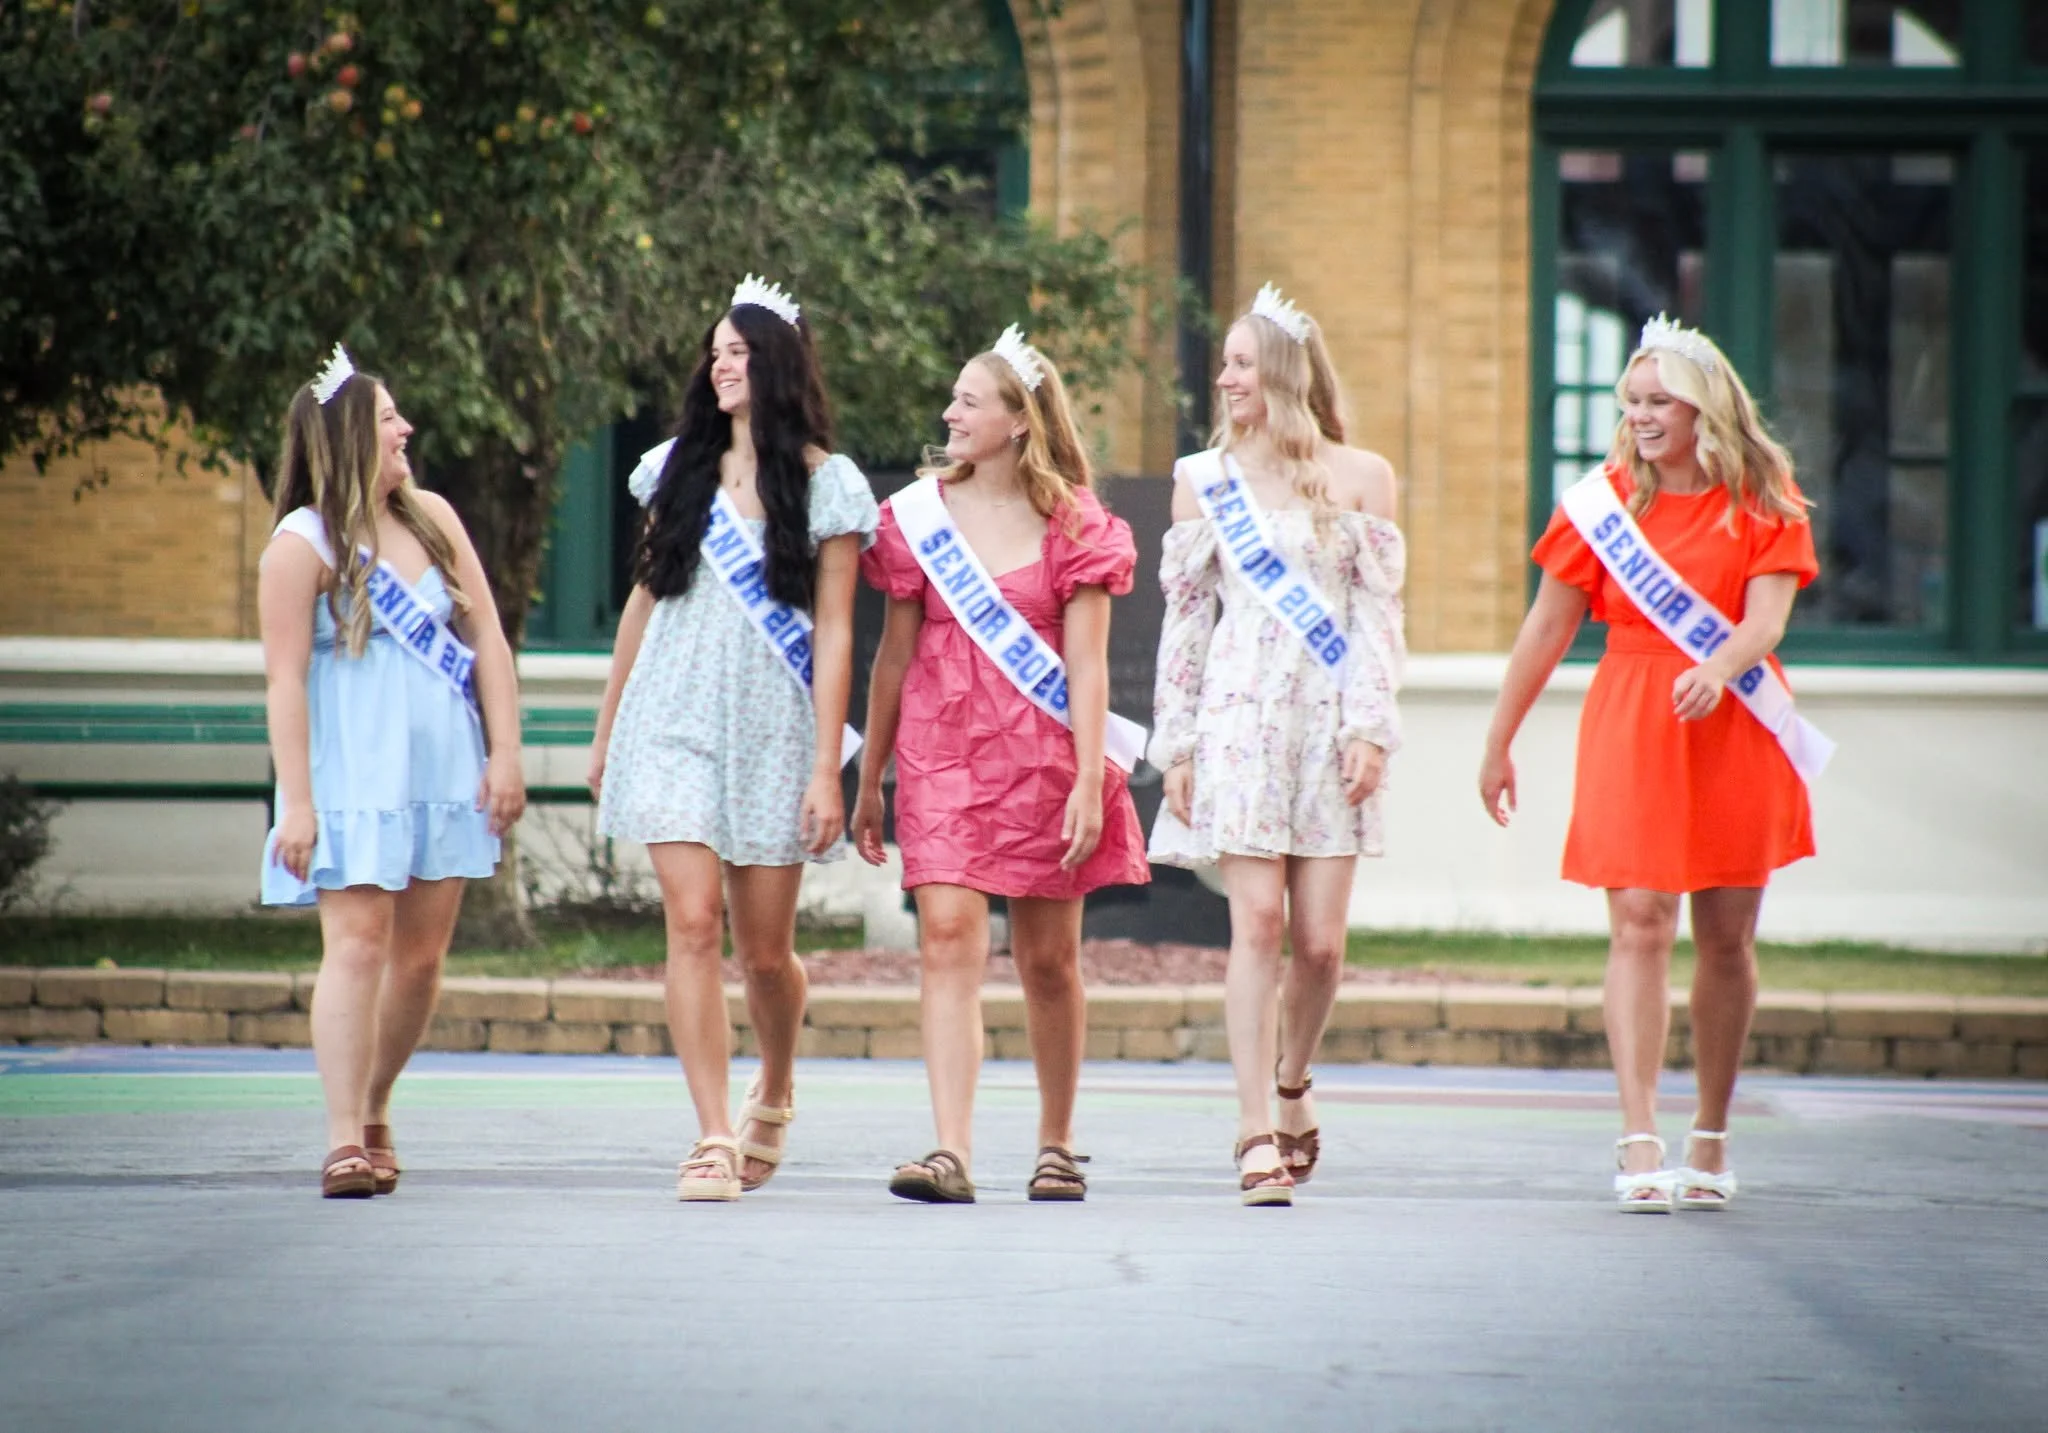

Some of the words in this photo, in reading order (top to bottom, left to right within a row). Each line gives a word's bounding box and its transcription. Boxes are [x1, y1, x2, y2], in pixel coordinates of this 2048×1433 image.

[702, 496, 769, 609] ENIOR
[919, 528, 1012, 643] SENIOR
[1593, 512, 1694, 625] SENIOR
[1686, 614, 1764, 697] 26
[359, 553, 437, 656] ENIOR
[439, 643, 475, 703] 20
[1276, 584, 1347, 666] 2026
